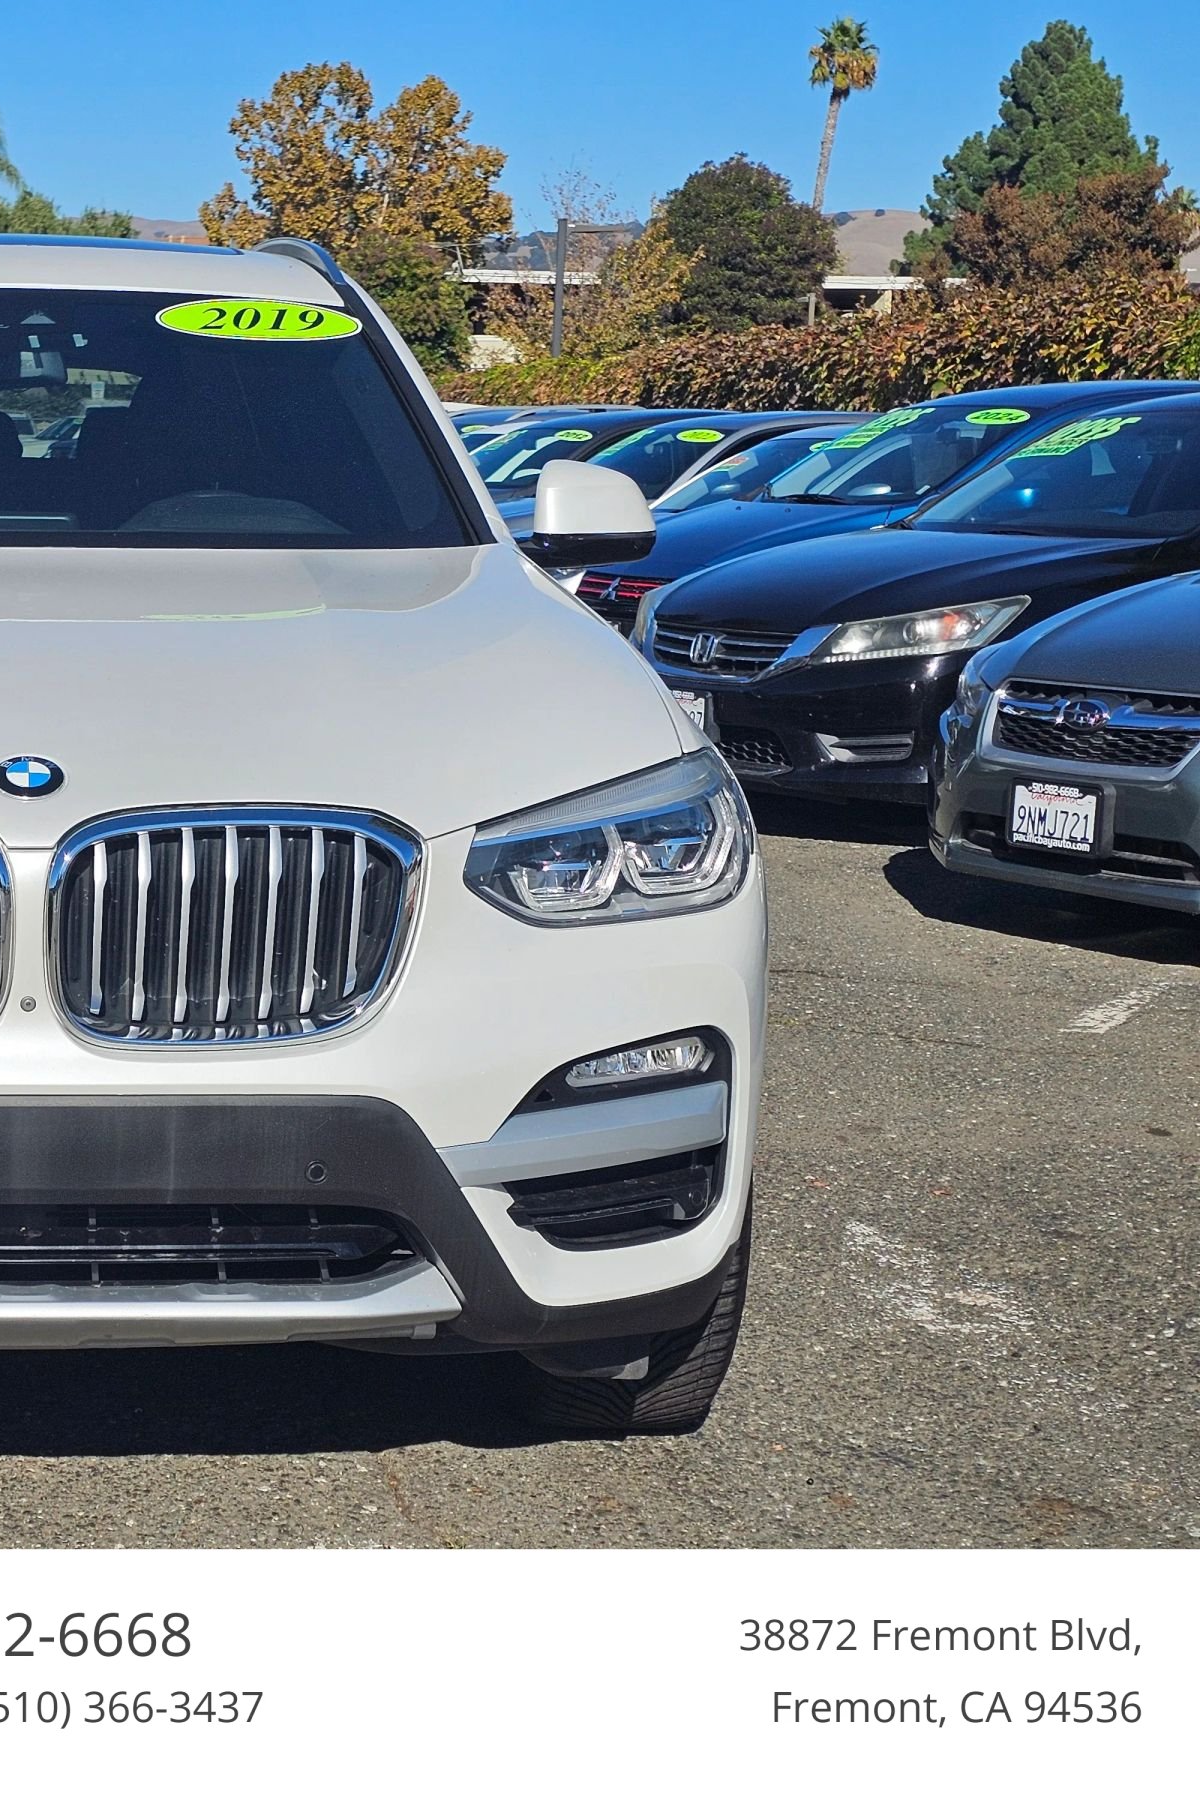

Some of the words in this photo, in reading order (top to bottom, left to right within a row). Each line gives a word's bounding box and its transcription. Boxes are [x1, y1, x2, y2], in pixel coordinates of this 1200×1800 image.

[198, 307, 325, 331] 2019
[1016, 805, 1090, 842] 9NMJ721
[1013, 832, 1091, 852] pacificbayauto.com
